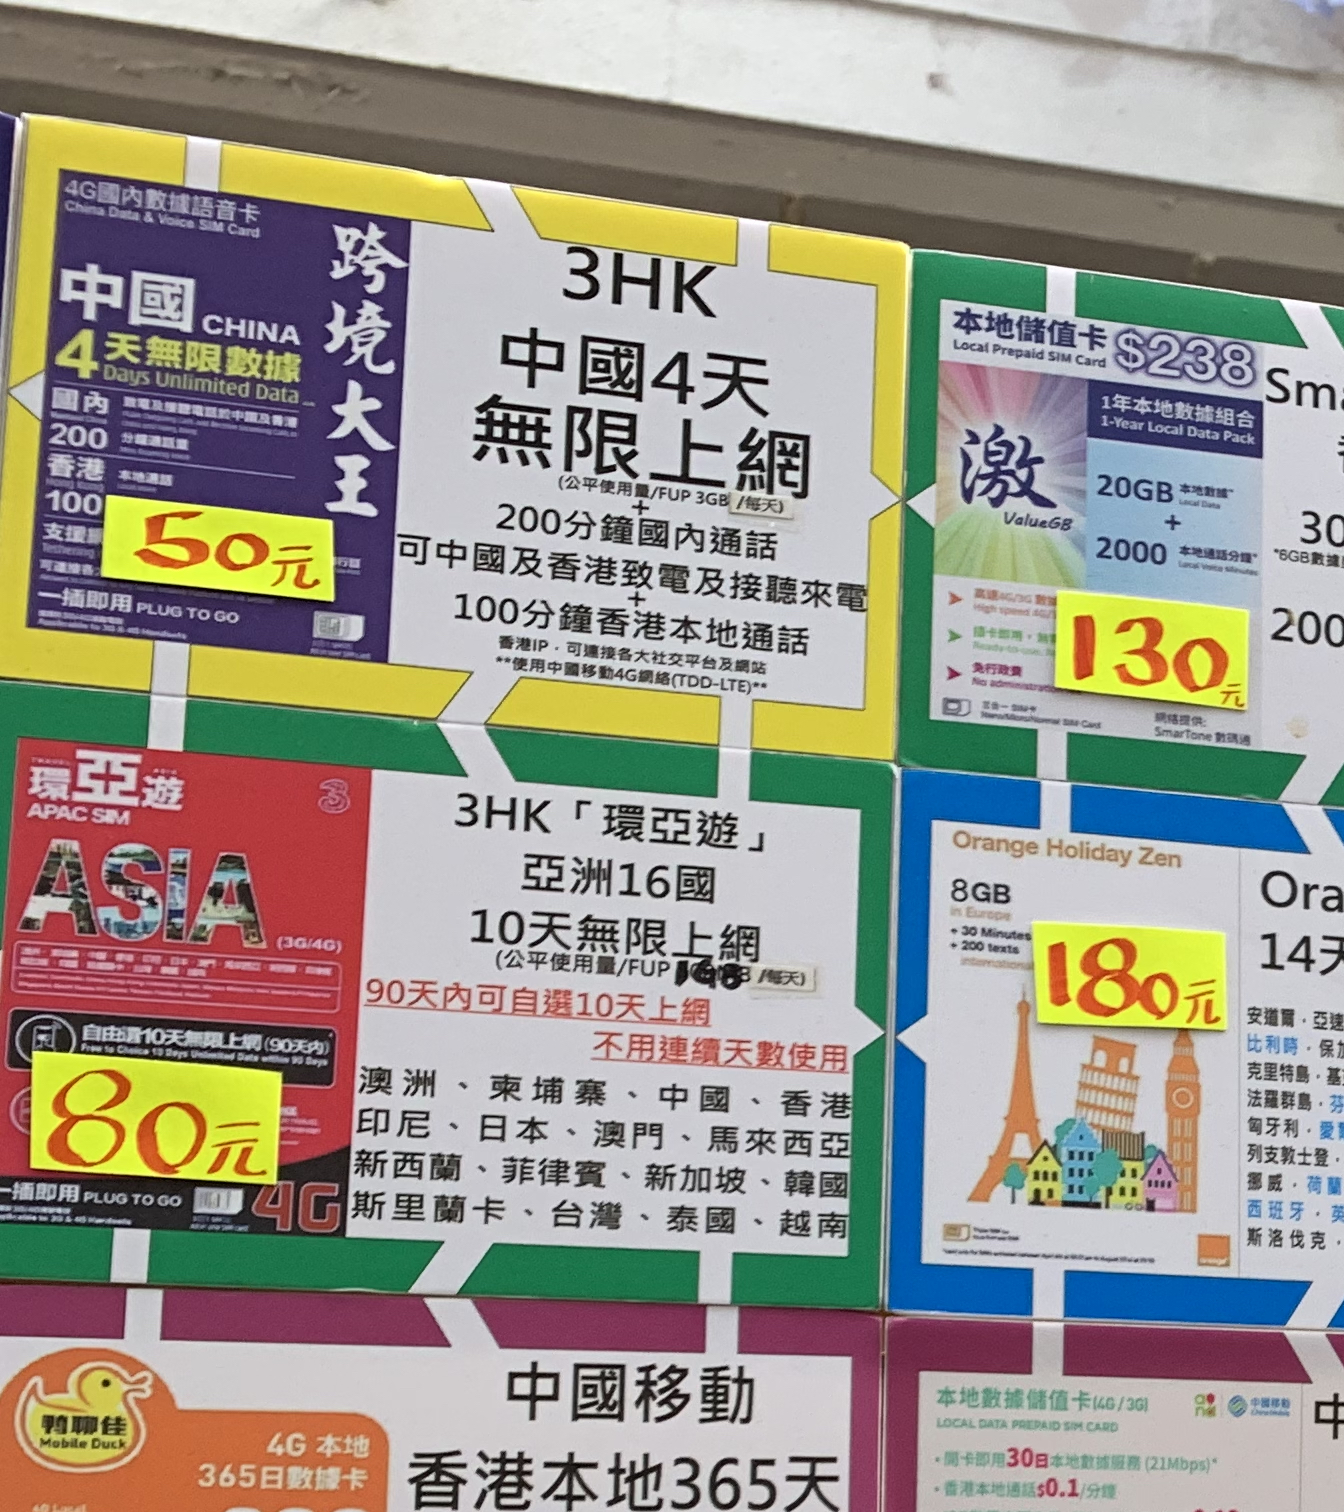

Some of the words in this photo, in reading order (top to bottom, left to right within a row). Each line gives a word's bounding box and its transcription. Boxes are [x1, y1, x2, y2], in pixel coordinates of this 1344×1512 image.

[58, 262, 196, 333] 中國
[202, 314, 300, 345] CHINA
[562, 247, 717, 319] 3HK
[322, 224, 410, 518] 跨境大王
[499, 327, 769, 418] 中國4天
[953, 306, 1108, 350] 本地儲值卡
[1114, 328, 1257, 387] $238
[473, 395, 812, 500] 無限上網
[959, 423, 1057, 509] 激
[1004, 511, 1074, 531] ValueGB
[1096, 473, 1174, 503] 20GB
[134, 510, 321, 592] 50元
[497, 503, 778, 560] 200分鐘國內通話
[397, 533, 870, 613] 可中國及香港致電及接聽來電
[454, 592, 809, 655] 100分鐘香港本地通話
[1072, 613, 1246, 708] 130元
[27, 803, 86, 825] APAC
[90, 805, 131, 827] SIM
[522, 853, 716, 905] 亞洲16國
[952, 829, 1039, 859] Orange
[1046, 837, 1130, 869] Holiday
[1137, 845, 1182, 870] Zen
[18, 838, 267, 949] ASIA
[949, 878, 1012, 905] 8GB
[470, 907, 761, 964] 10天無限上網
[364, 977, 712, 1028] 90天內可自選10天上網
[1046, 937, 1220, 1024] 180元
[592, 1032, 849, 1073] 不用連續天數使用
[44, 1068, 270, 1178] 80元
[506, 1363, 755, 1425] 中國移動
[39, 1436, 89, 1452] Mobile
[91, 1436, 129, 1452] Duck
